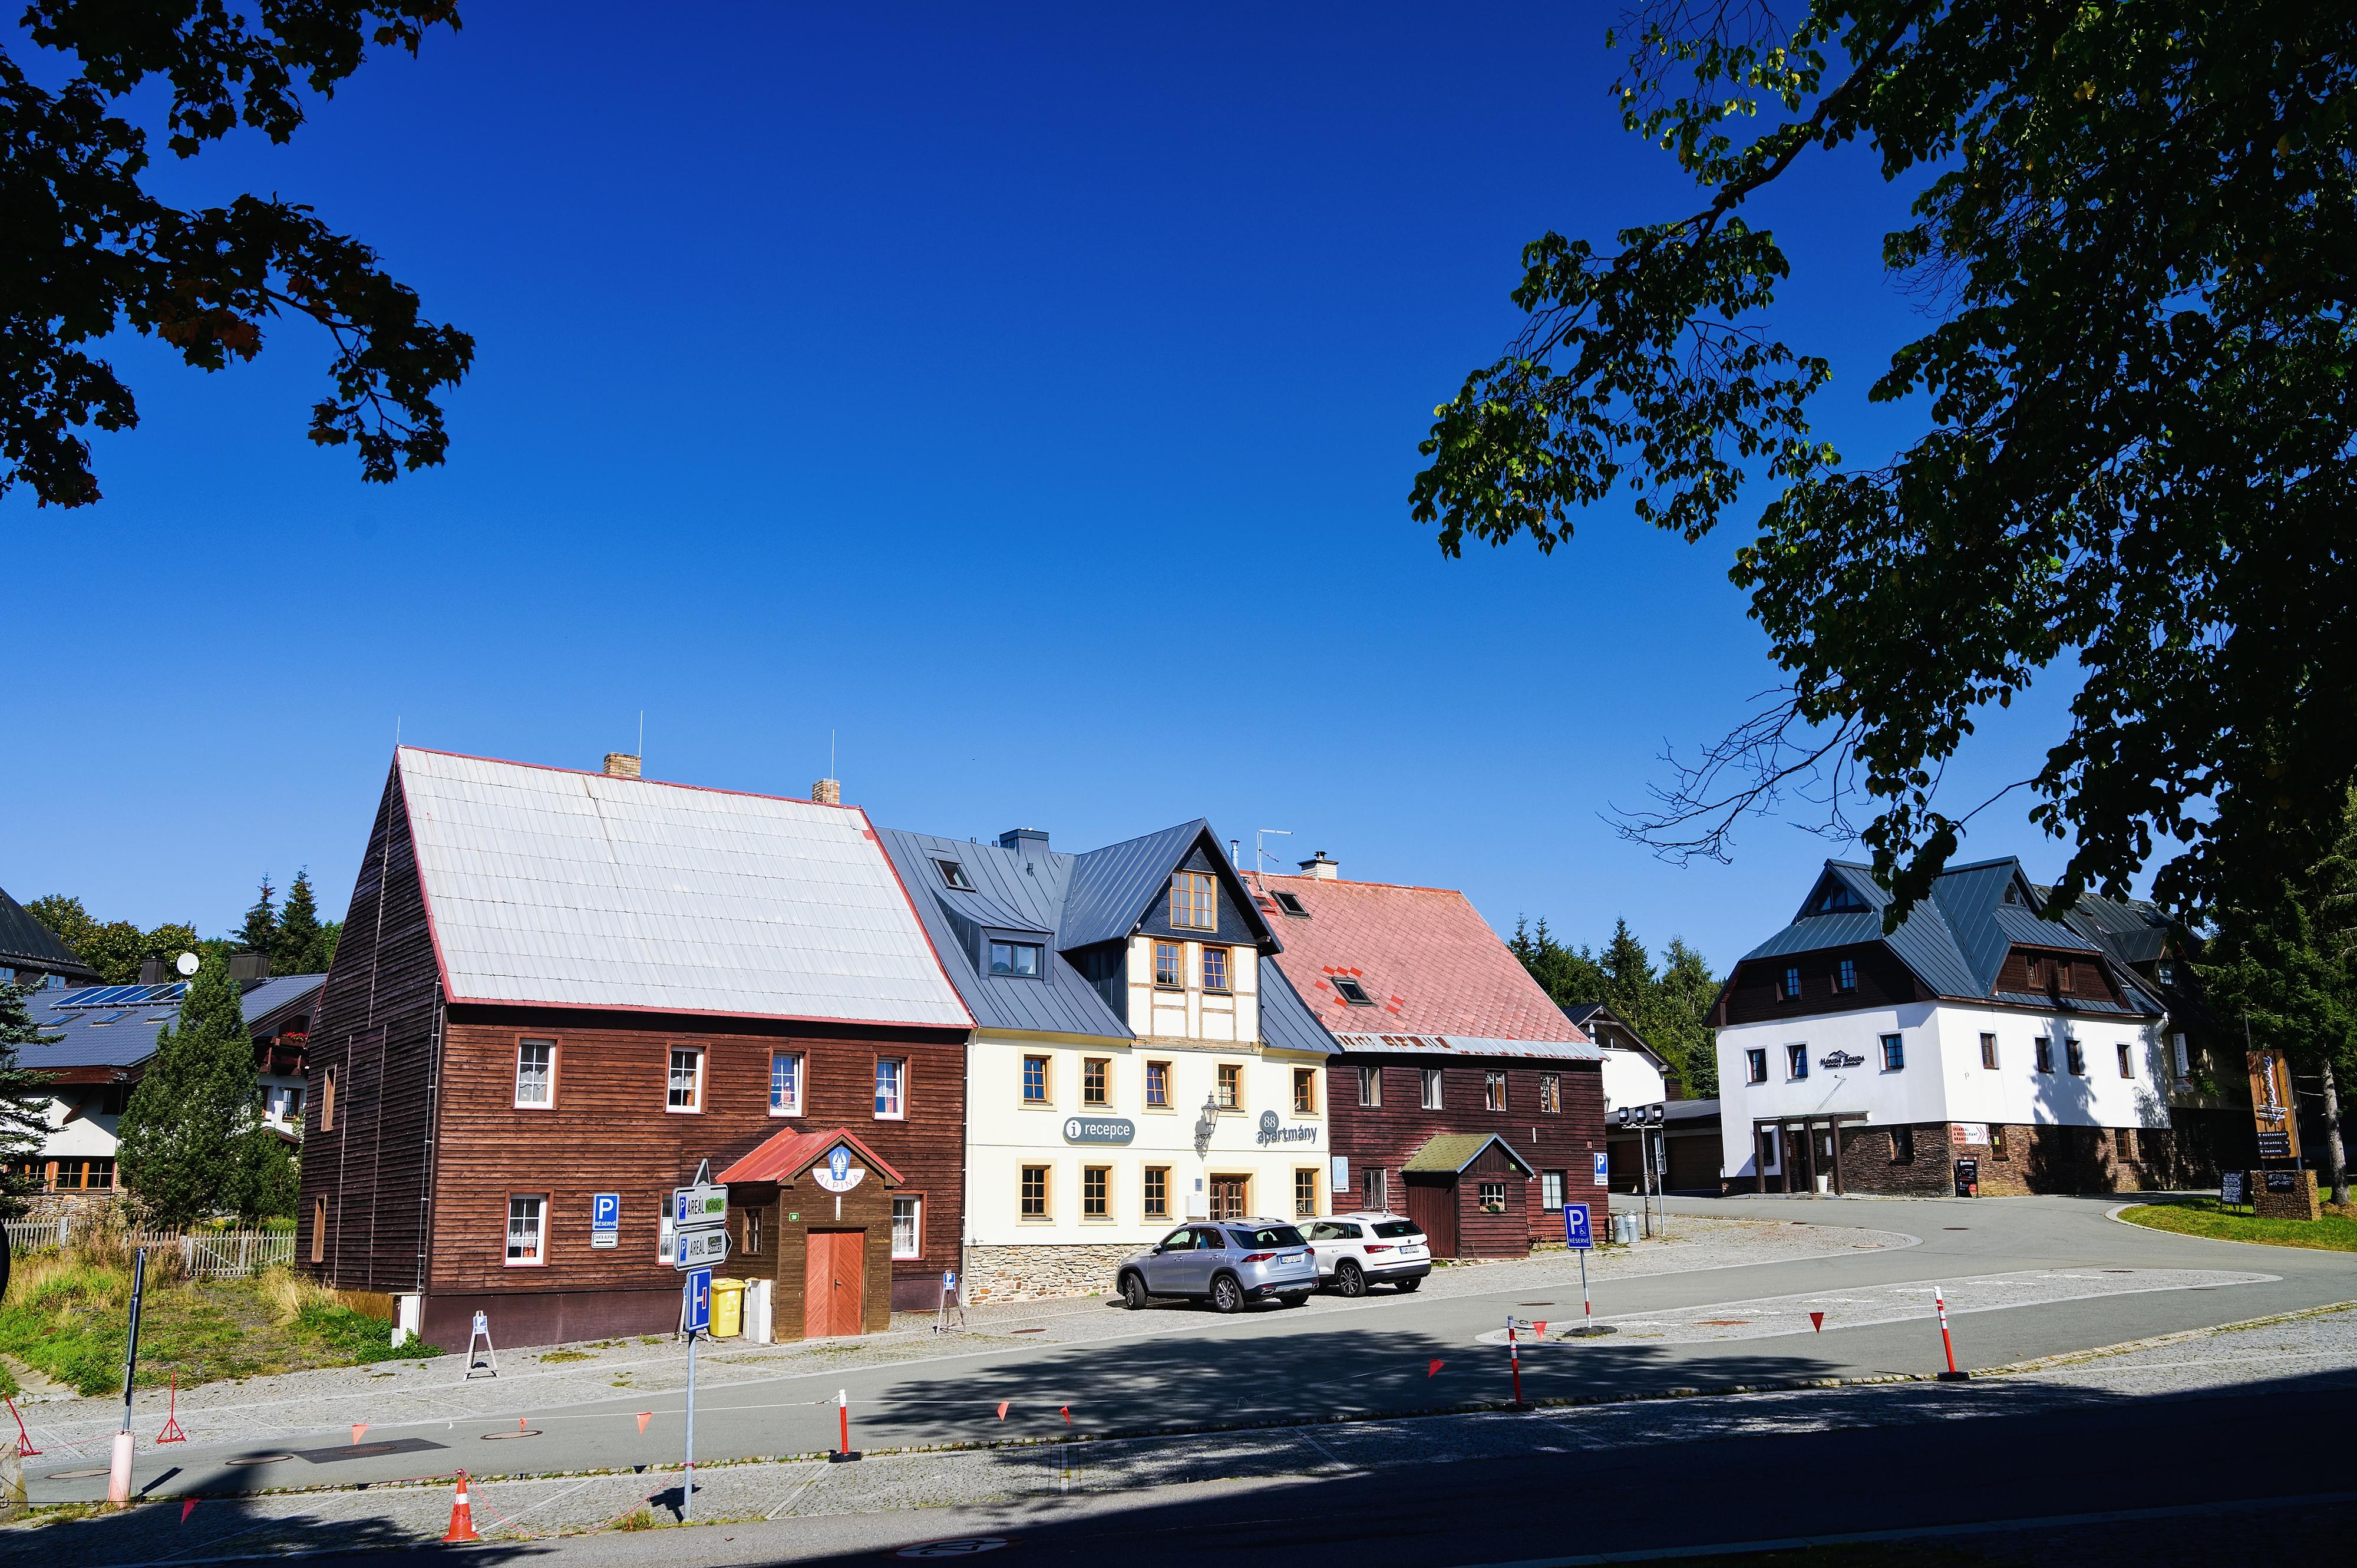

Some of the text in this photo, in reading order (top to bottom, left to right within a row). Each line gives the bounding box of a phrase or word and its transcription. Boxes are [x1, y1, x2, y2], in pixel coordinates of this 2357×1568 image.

[1264, 1116, 1276, 1128] 88
[1085, 1124, 1130, 1140] recepce
[1257, 1125, 1317, 1146] apartmány
[1597, 1155, 1605, 1170] P
[817, 1174, 861, 1189] ALPINA
[599, 1198, 614, 1219] P
[680, 1199, 685, 1213] P
[687, 1196, 704, 1215] AREÁL
[1569, 1210, 1584, 1234] P
[681, 1241, 686, 1255] P
[689, 1236, 705, 1256] AREÁL
[946, 1273, 952, 1283] P
[477, 1317, 484, 1326] P
